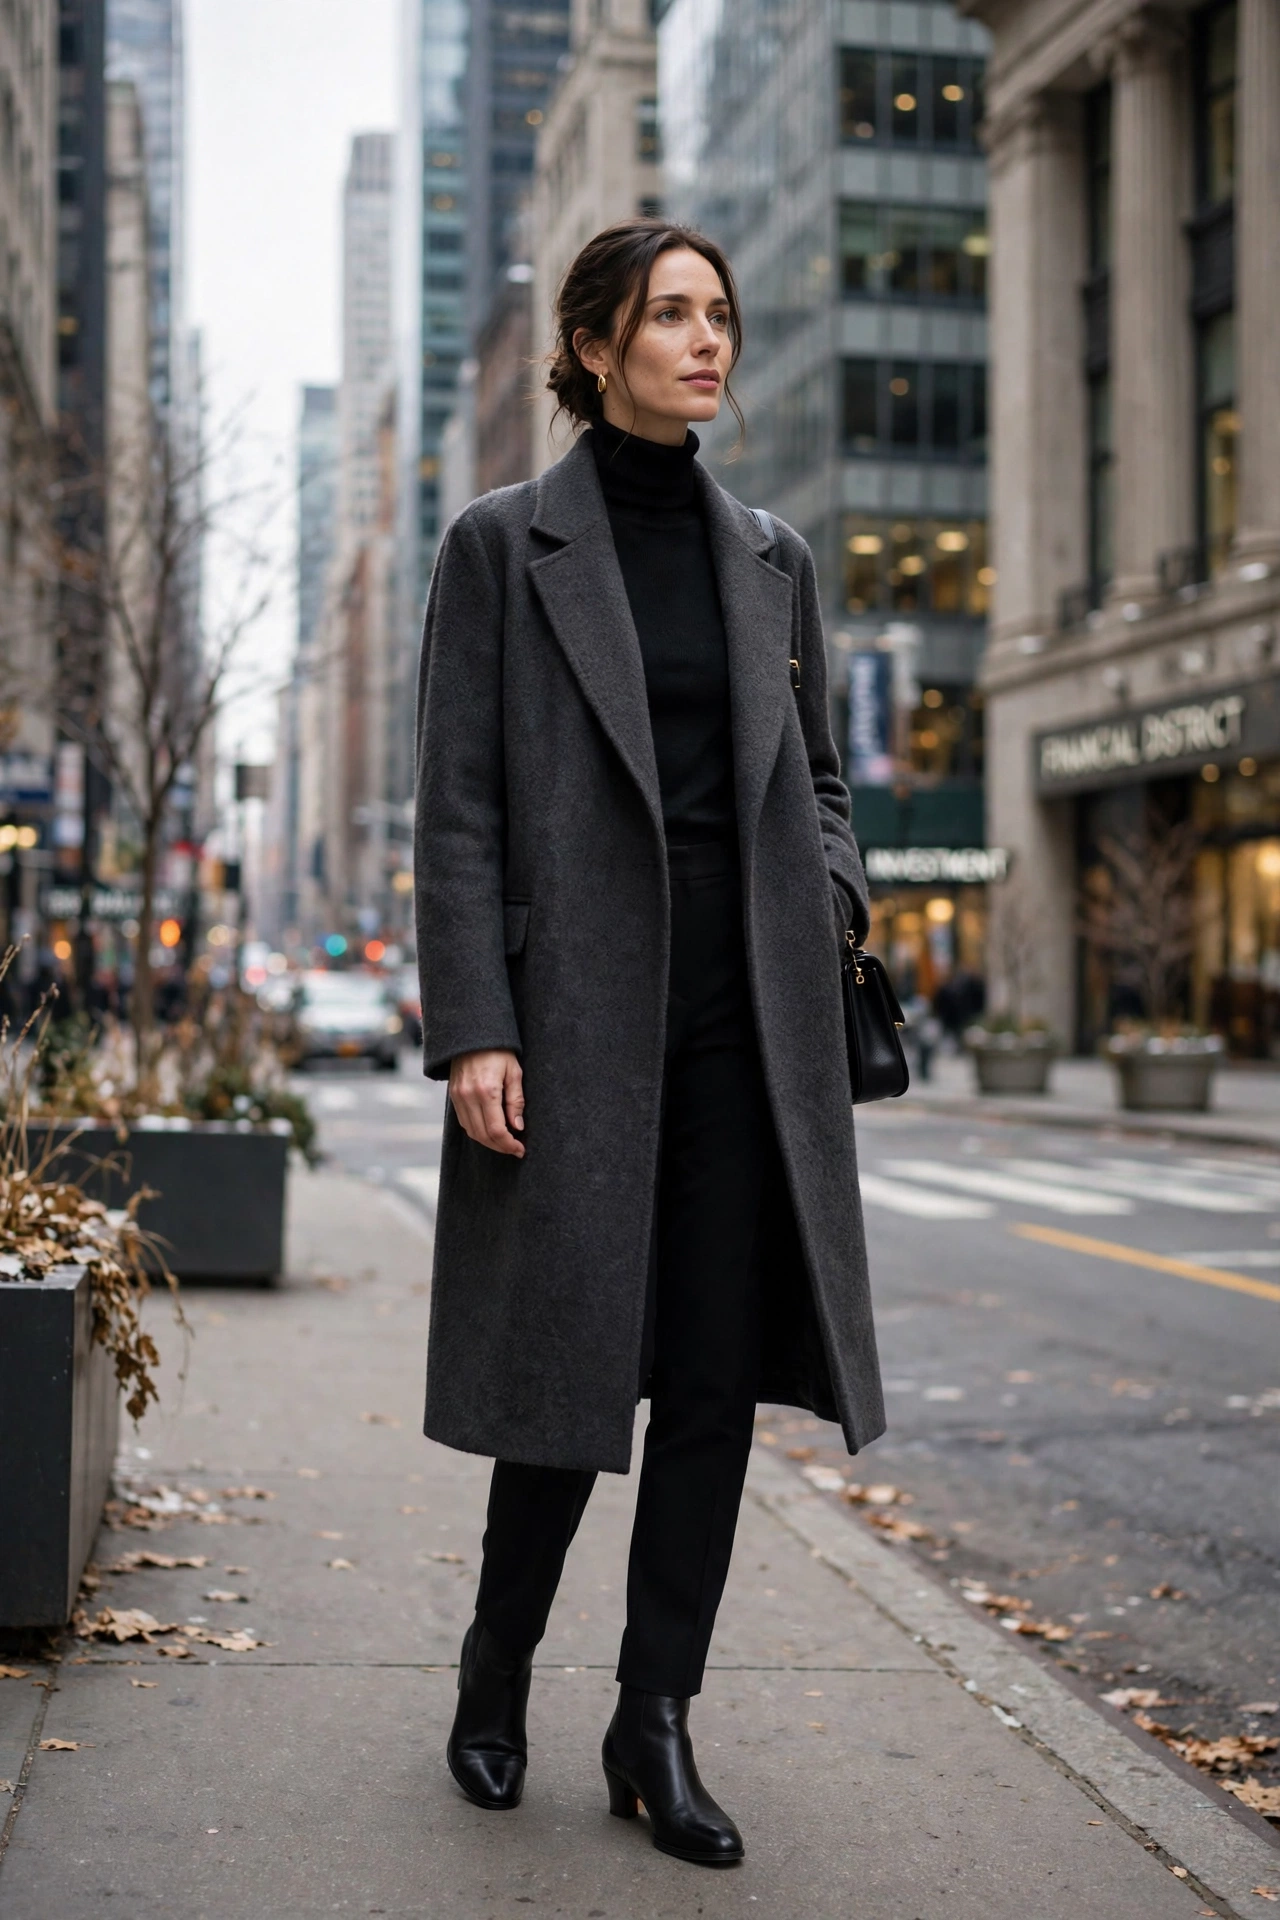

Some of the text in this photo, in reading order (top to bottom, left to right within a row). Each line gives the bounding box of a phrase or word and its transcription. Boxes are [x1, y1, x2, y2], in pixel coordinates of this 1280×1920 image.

[1041, 696, 1244, 778] FINANCIAL DISTRICT
[866, 848, 1008, 882] INVESTMENT
